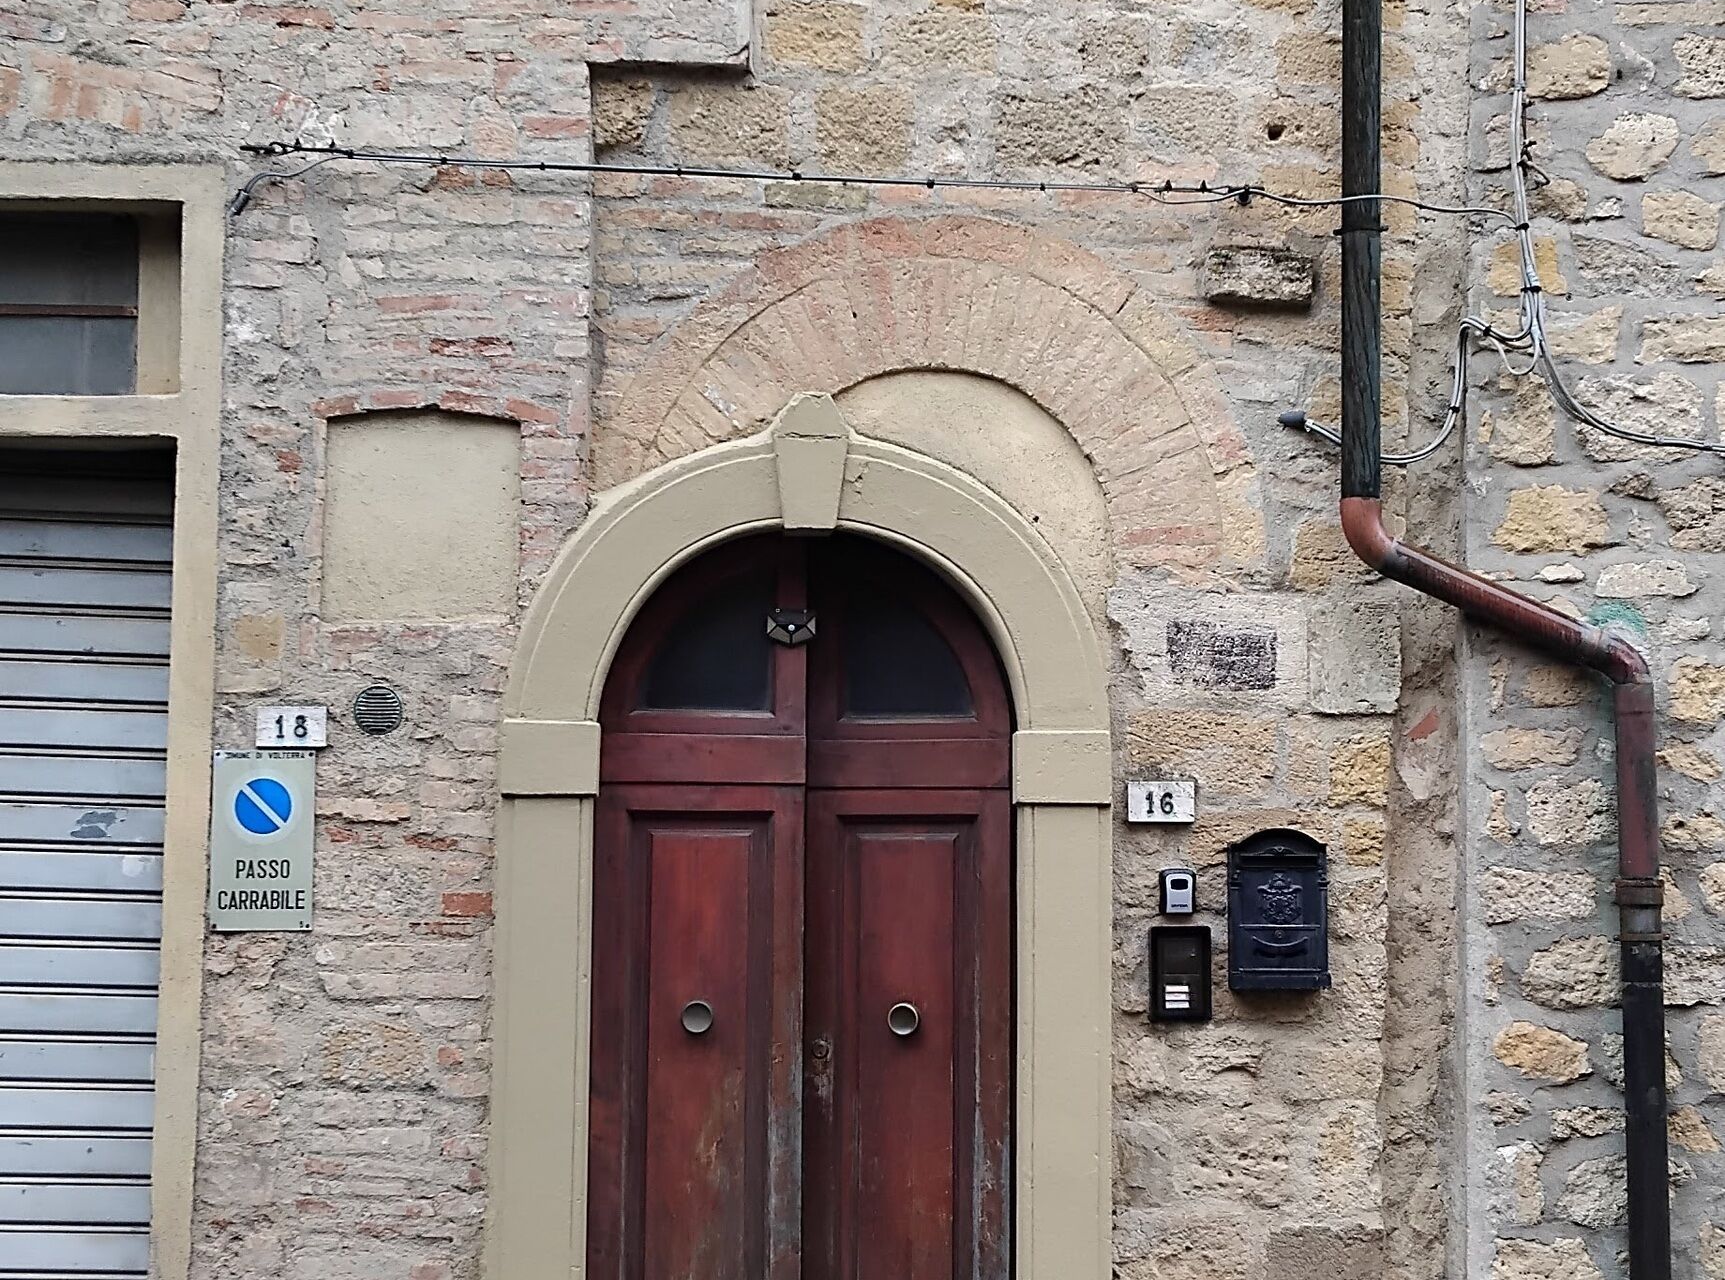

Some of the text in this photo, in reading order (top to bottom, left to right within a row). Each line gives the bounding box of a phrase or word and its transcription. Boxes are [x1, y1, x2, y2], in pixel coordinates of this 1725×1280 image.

[275, 715, 308, 738] 18
[1145, 791, 1174, 815] 16
[235, 859, 291, 879] PASSO
[217, 890, 306, 910] CARRABILE
